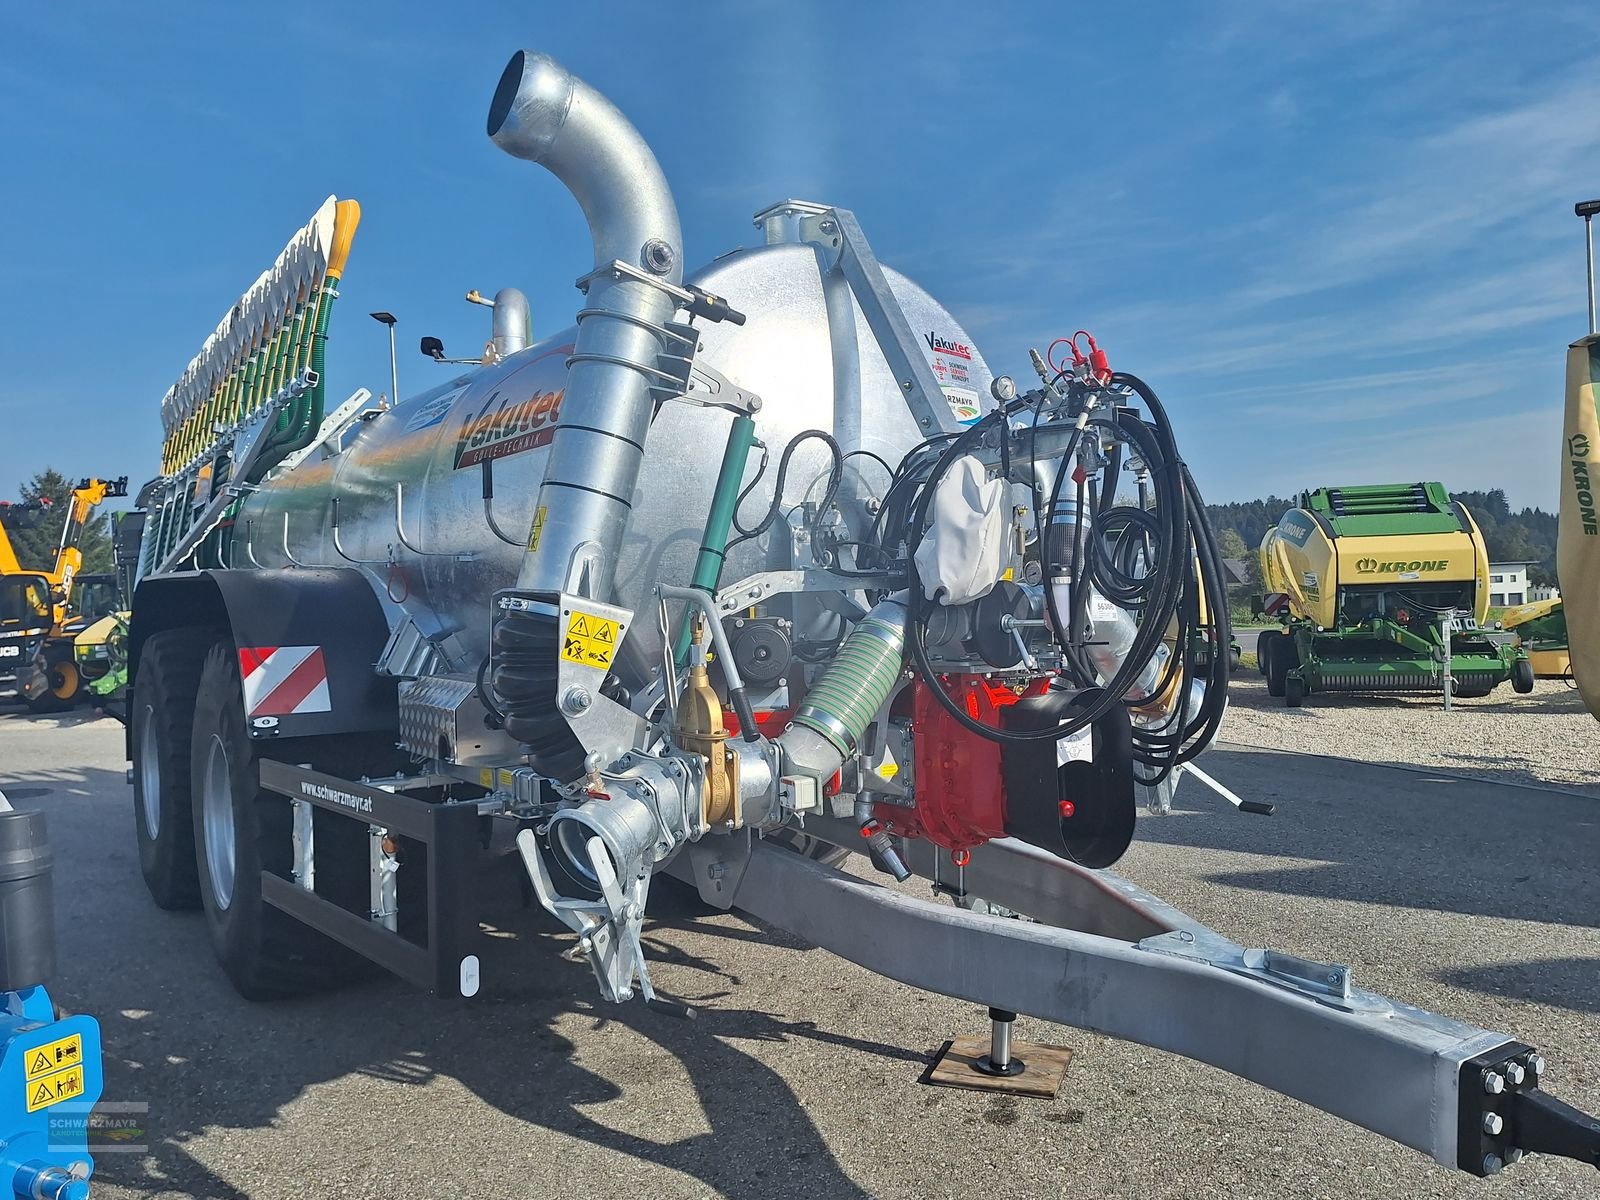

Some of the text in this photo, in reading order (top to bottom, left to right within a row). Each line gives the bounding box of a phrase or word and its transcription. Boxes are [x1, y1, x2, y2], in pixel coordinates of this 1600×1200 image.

[924, 331, 970, 355] Vakutec
[1572, 460, 1598, 535] KRONE
[1282, 522, 1306, 539] KRONE
[1376, 560, 1449, 574] KRONE
[300, 781, 373, 813] www.schwarzmayr.at
